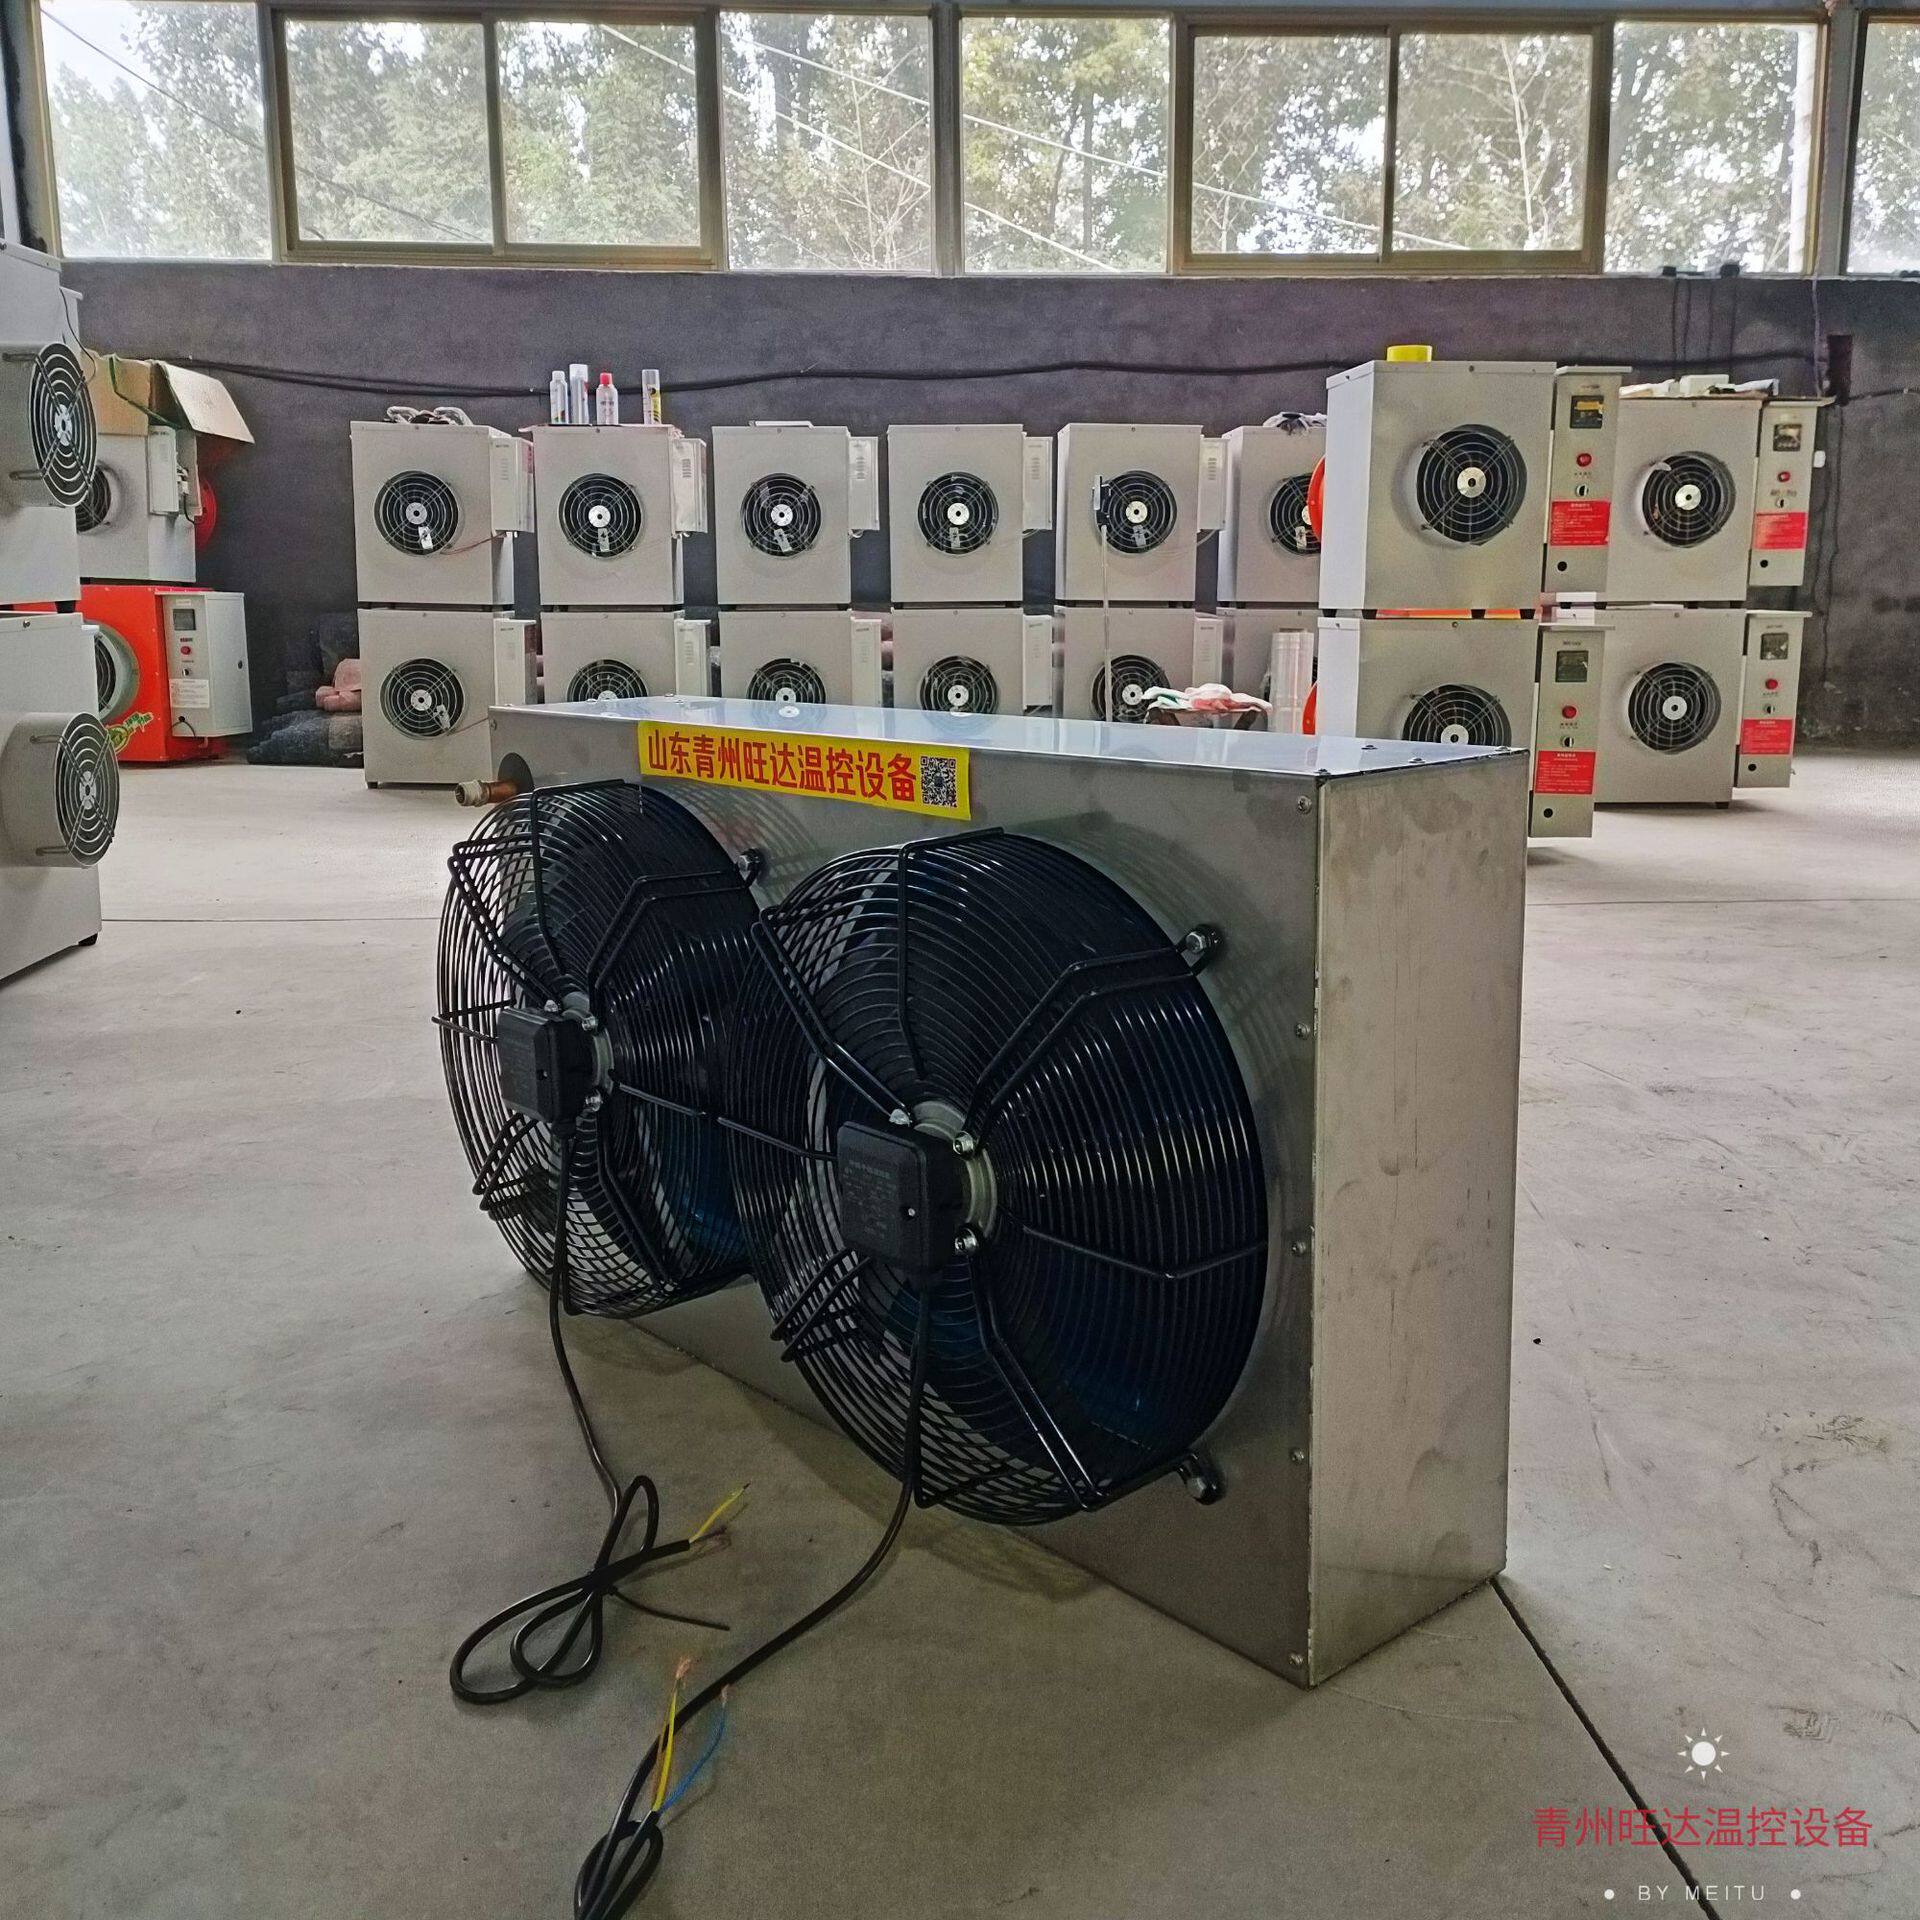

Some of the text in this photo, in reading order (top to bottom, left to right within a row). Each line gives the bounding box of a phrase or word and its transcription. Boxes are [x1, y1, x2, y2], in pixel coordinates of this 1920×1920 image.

[647, 729, 917, 803] 山东青州旺达温控设备
